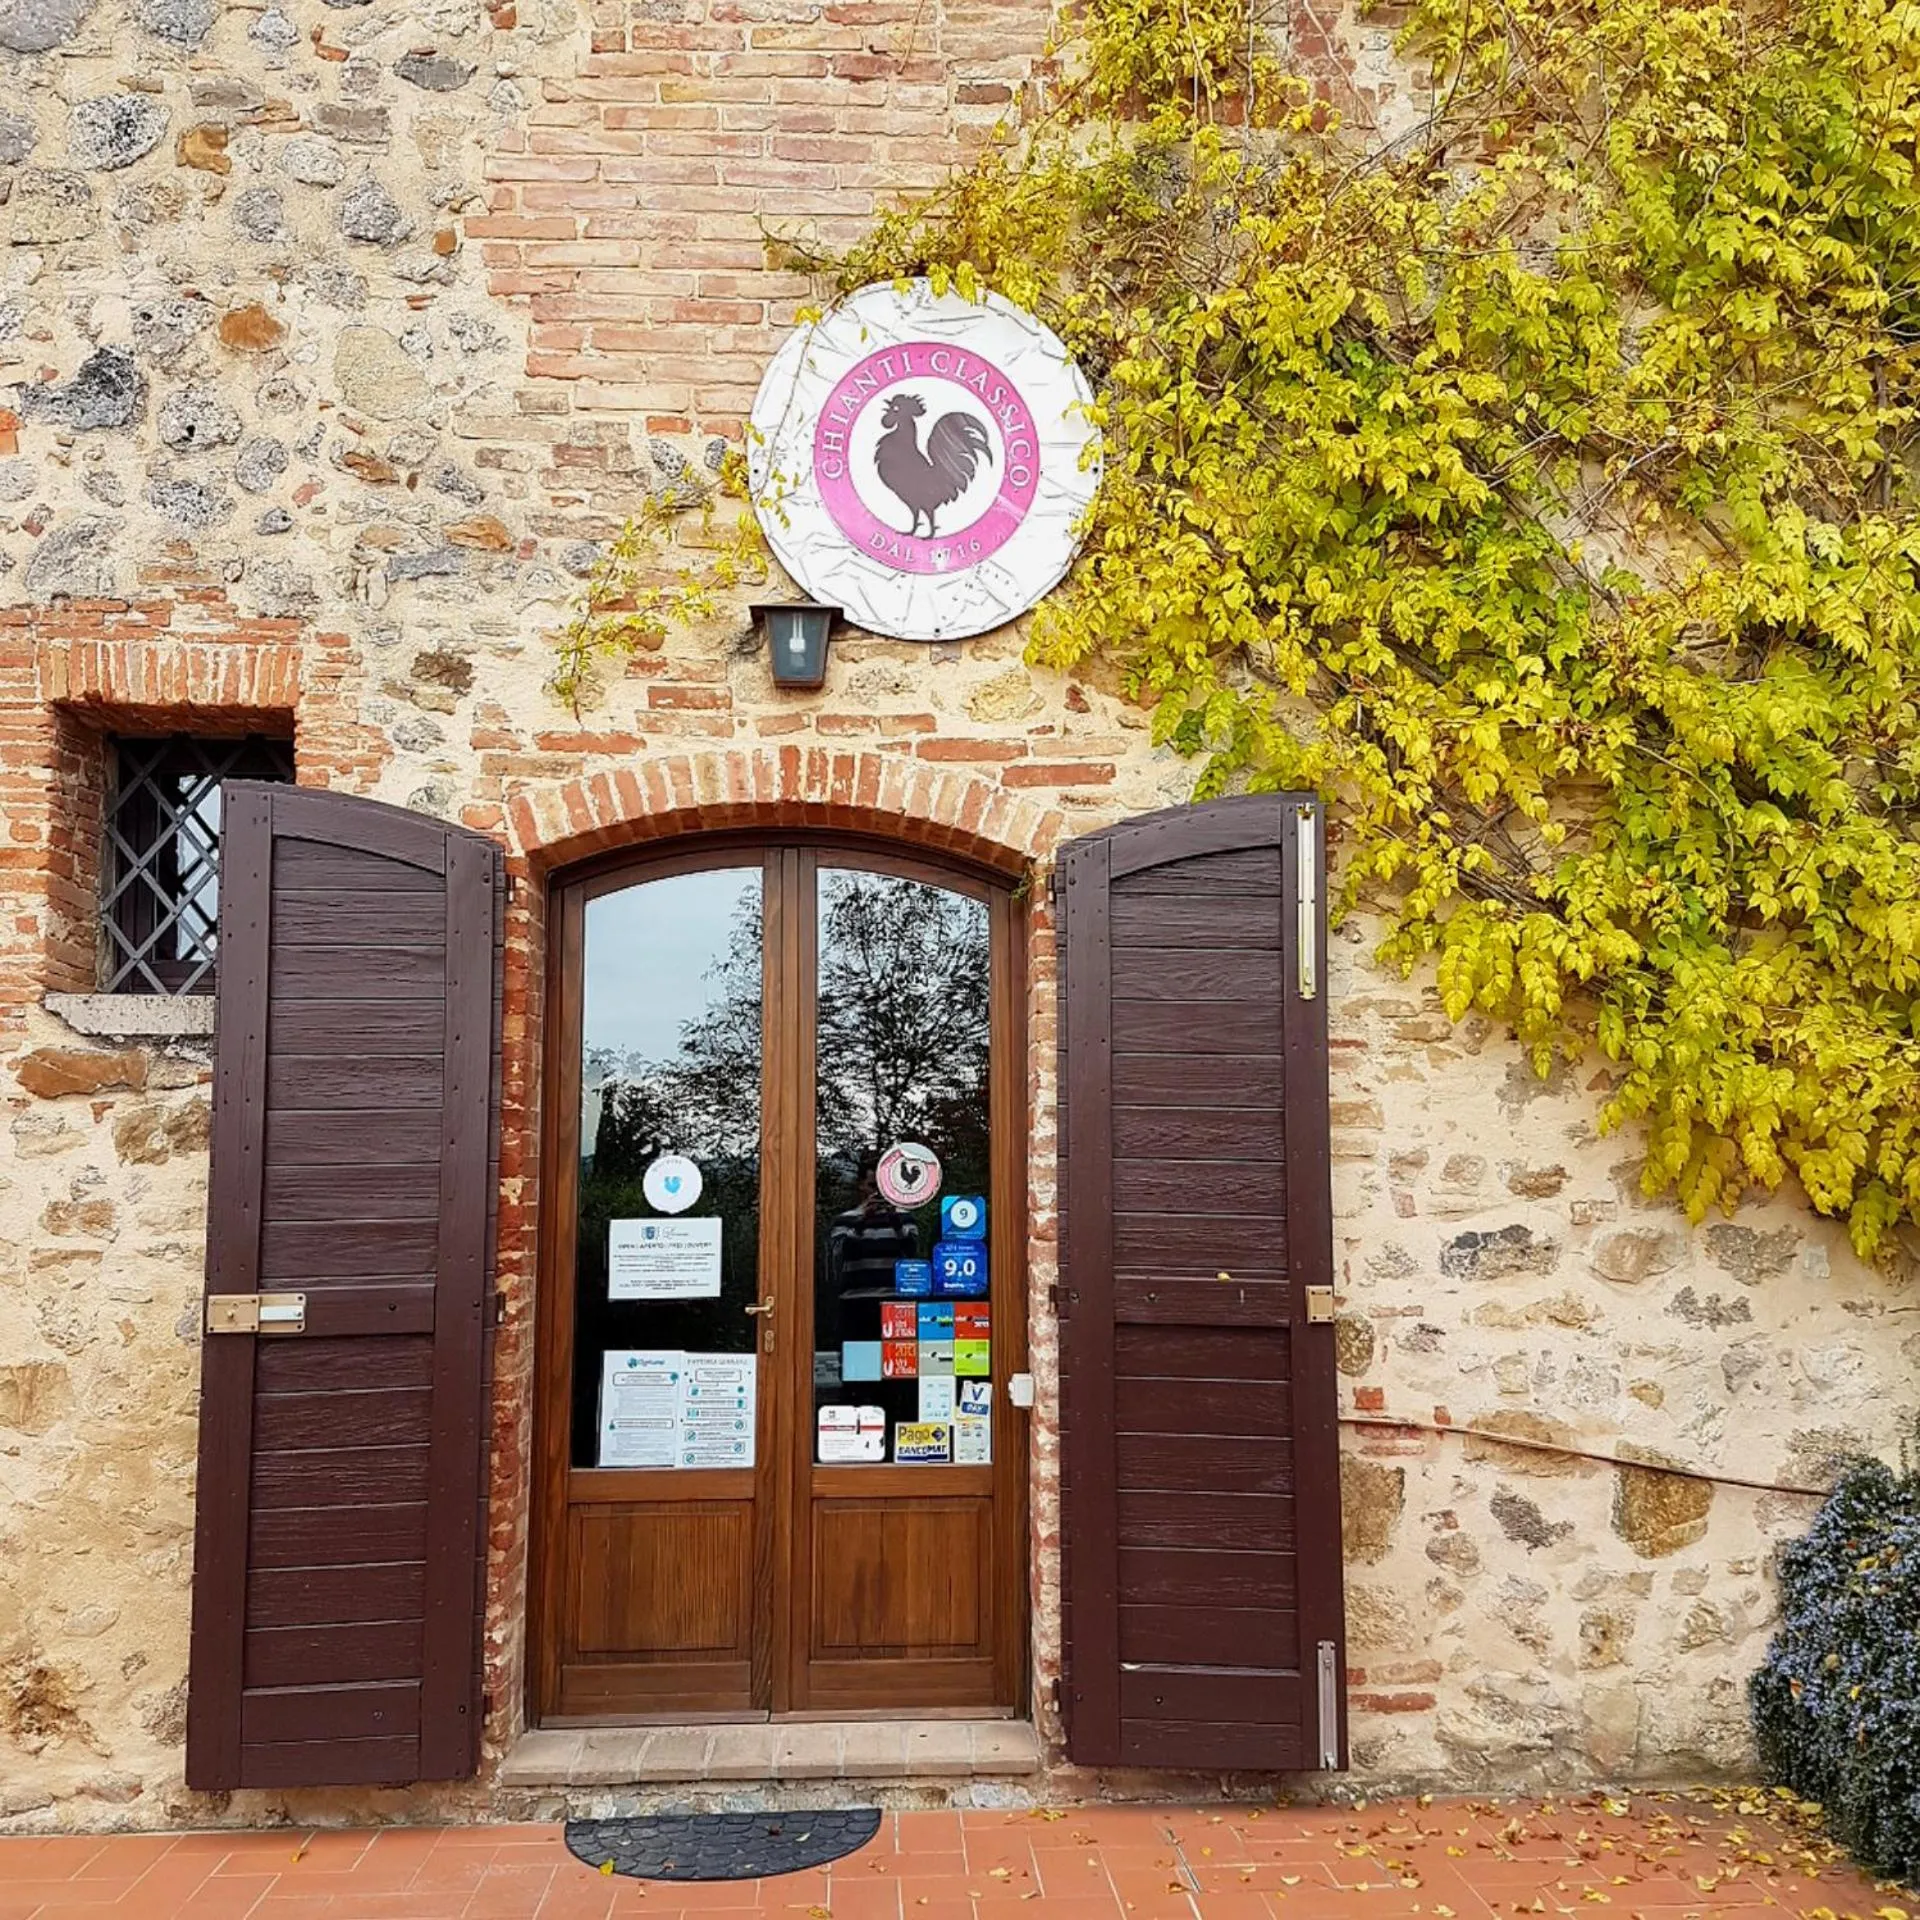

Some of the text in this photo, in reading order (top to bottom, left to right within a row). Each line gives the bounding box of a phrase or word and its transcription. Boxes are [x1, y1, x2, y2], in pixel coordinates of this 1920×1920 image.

[821, 350, 1032, 489] CHIANTI CLASSICO
[870, 532, 914, 562] DAL
[959, 1208, 968, 1220] 9
[944, 1259, 976, 1277] 9.0
[898, 1425, 930, 1445] Pago
